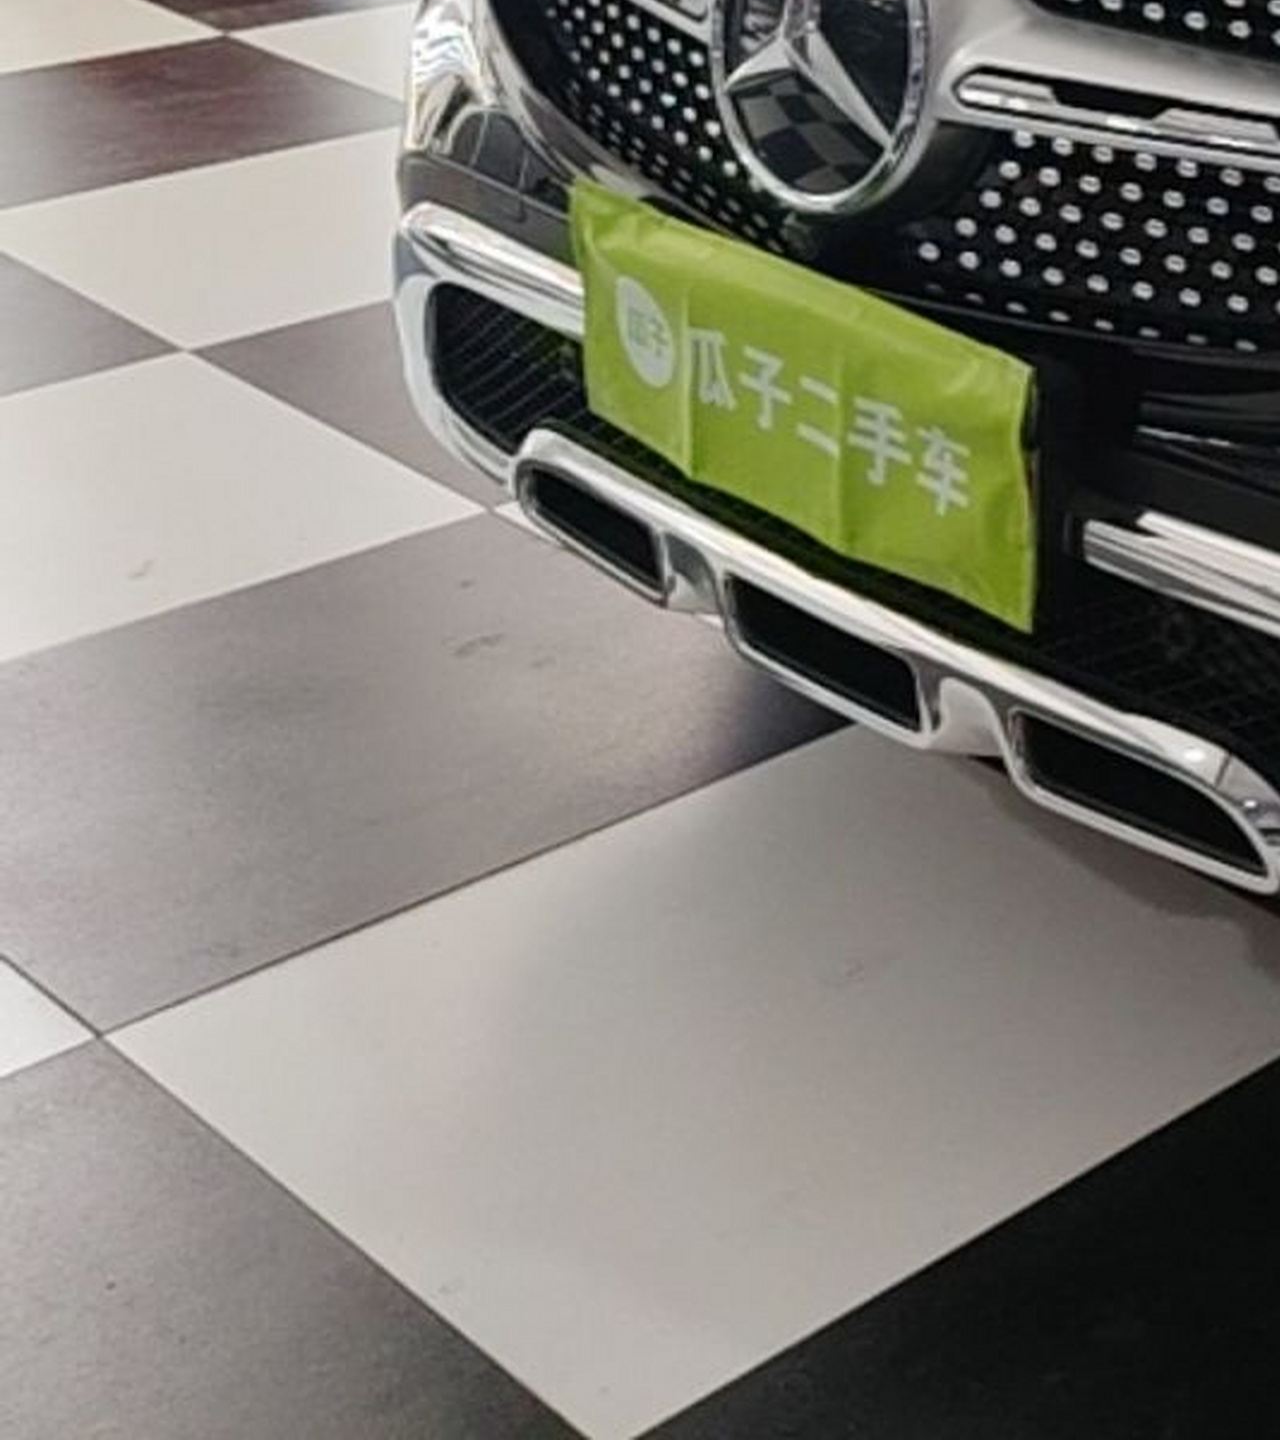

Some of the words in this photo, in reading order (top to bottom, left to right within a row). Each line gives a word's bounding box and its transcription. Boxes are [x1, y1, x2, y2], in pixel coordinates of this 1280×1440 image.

[687, 325, 970, 517] 瓜子二手车
